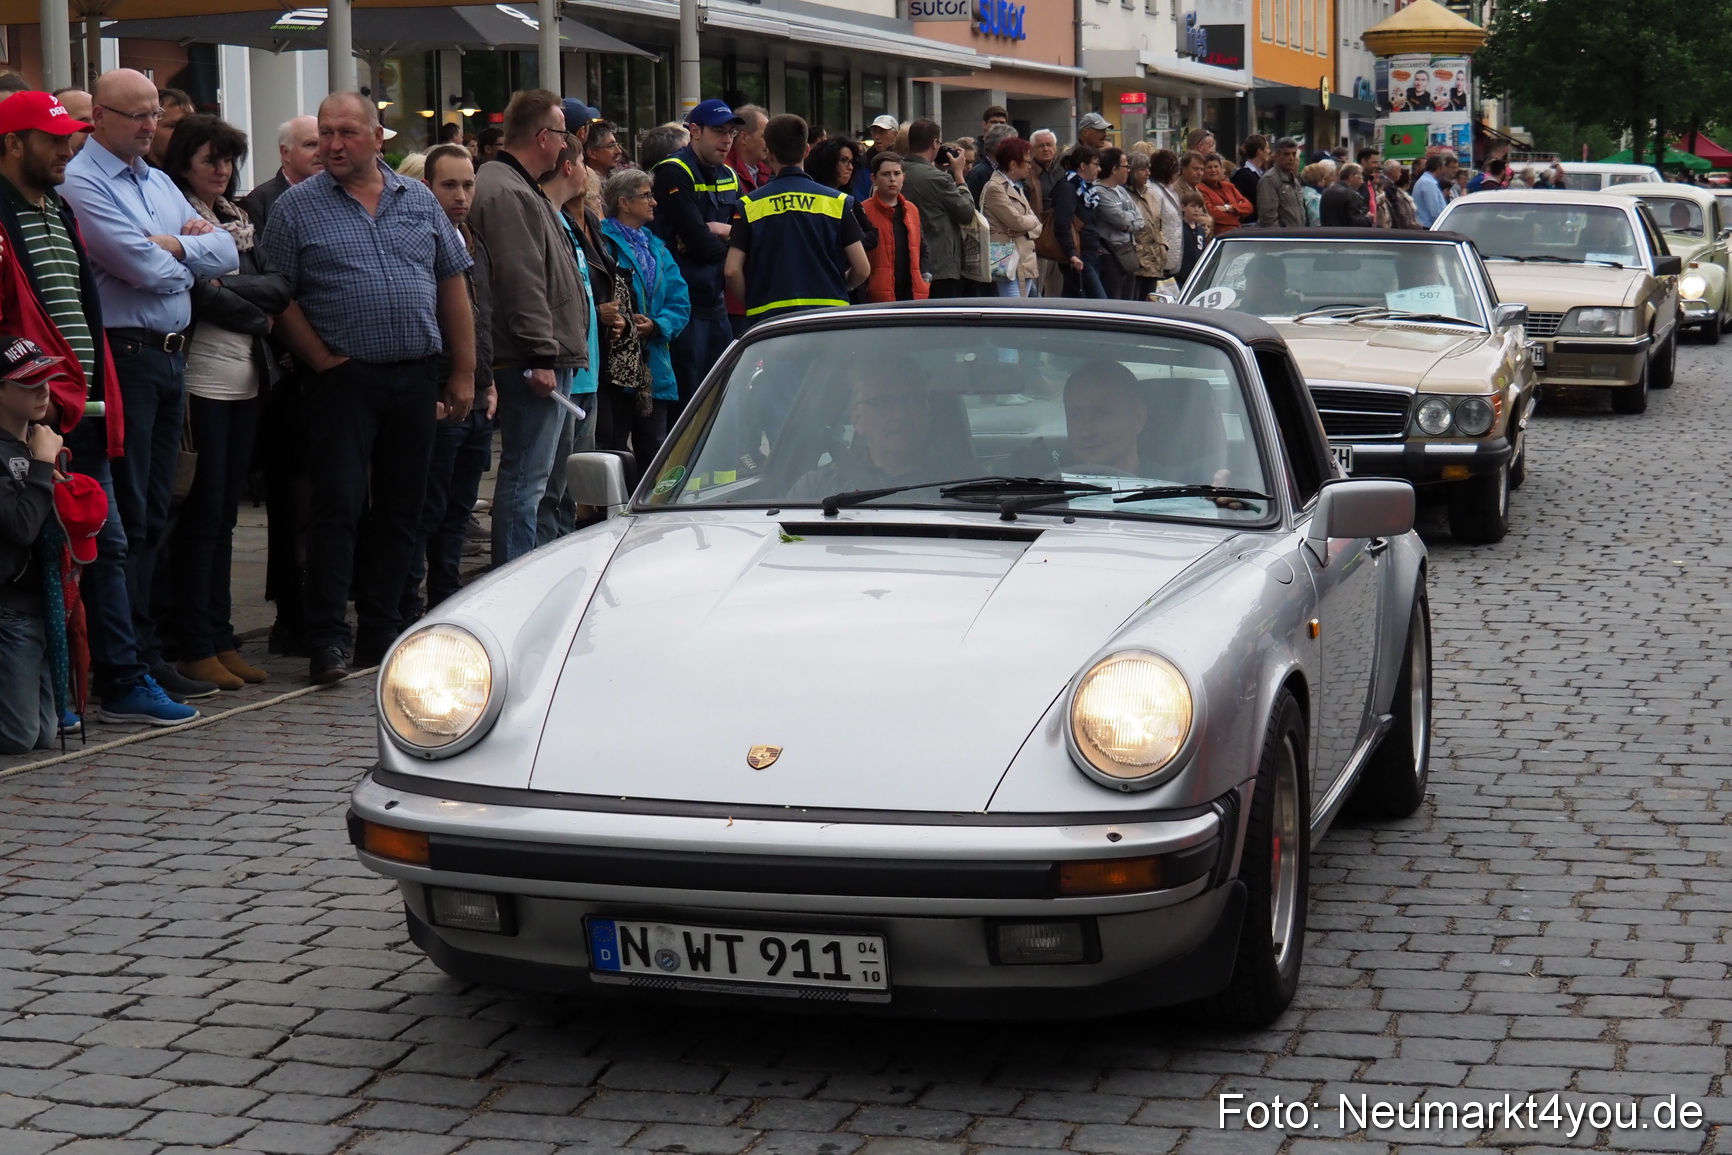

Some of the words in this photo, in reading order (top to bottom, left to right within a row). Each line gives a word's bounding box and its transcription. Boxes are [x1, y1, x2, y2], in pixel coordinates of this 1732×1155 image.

[769, 194, 816, 212] THW
[1419, 291, 1441, 299] 507
[4, 341, 28, 363] NEW
[620, 926, 651, 967] N
[683, 931, 744, 974] WT
[759, 937, 851, 981] 911
[858, 942, 877, 954] 04
[601, 949, 611, 961] D
[862, 971, 880, 982] 10
